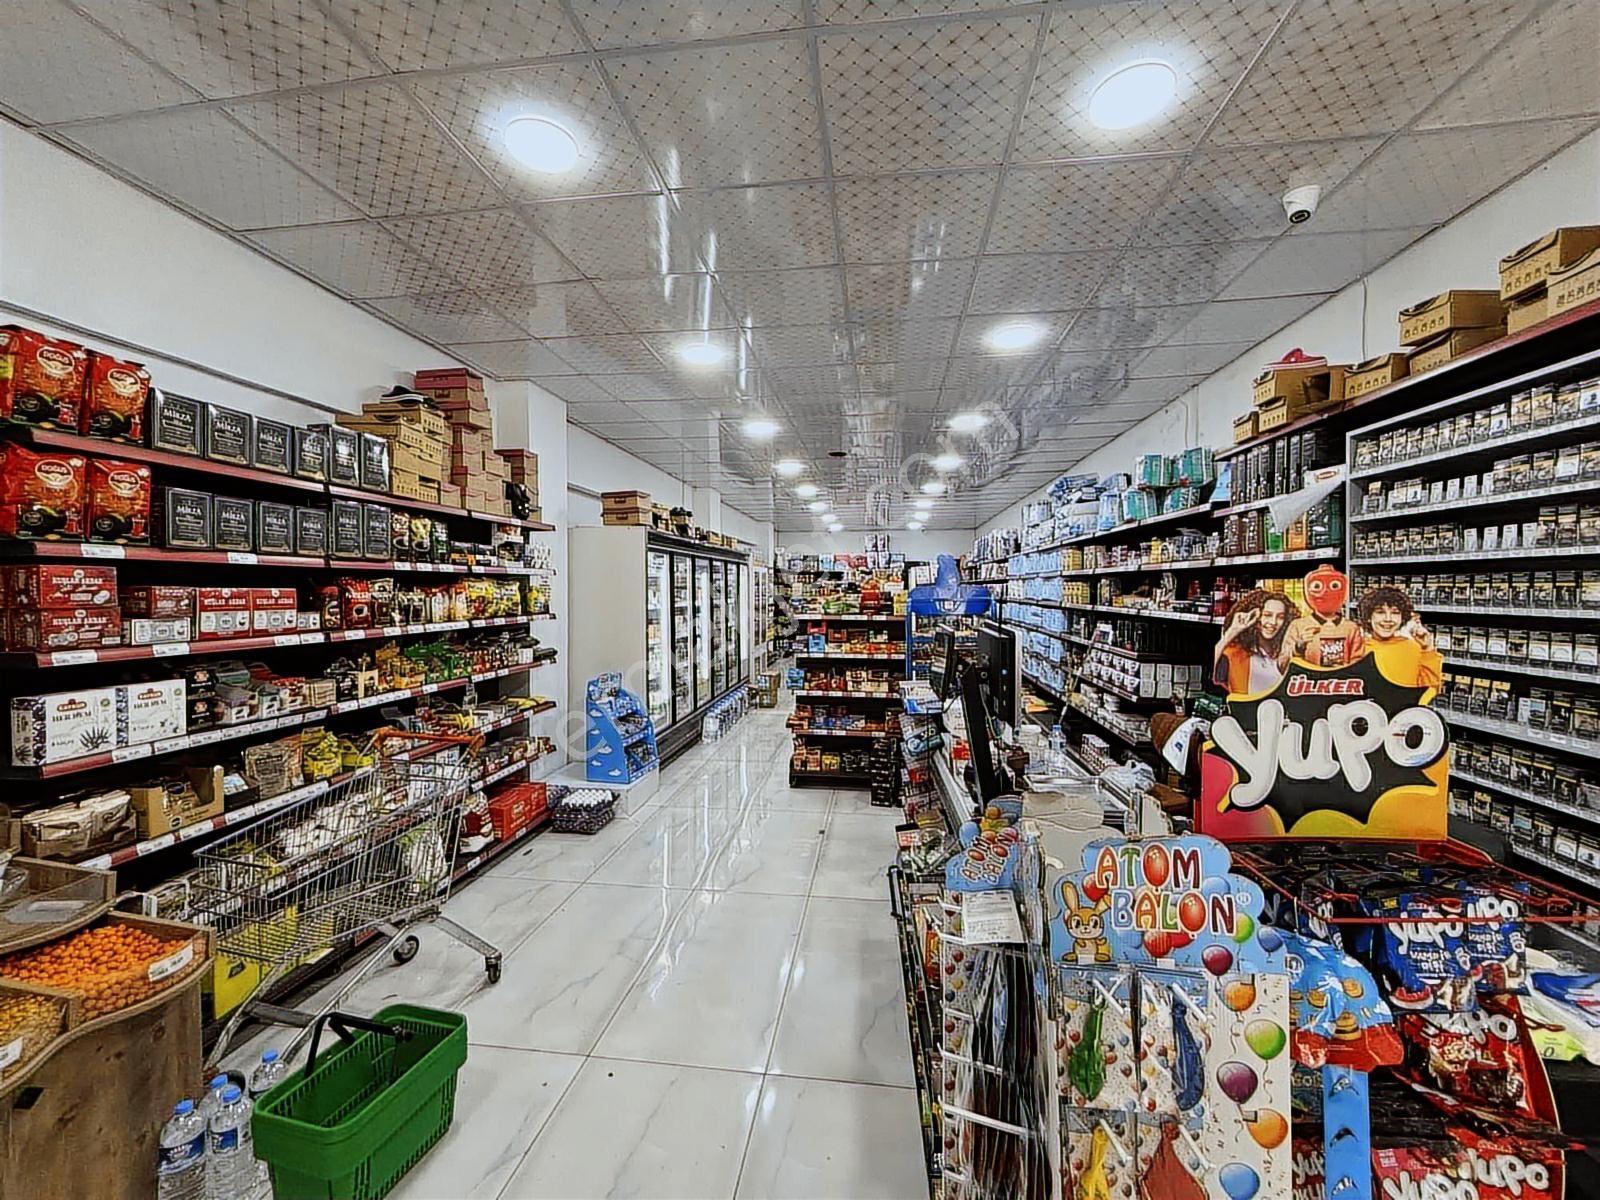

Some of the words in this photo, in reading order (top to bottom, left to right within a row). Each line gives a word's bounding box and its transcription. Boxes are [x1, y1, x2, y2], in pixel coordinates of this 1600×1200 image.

[1287, 674, 1363, 696] ÜLKER
[1094, 844, 1202, 890] ATOM
[1110, 889, 1237, 937] BALON
